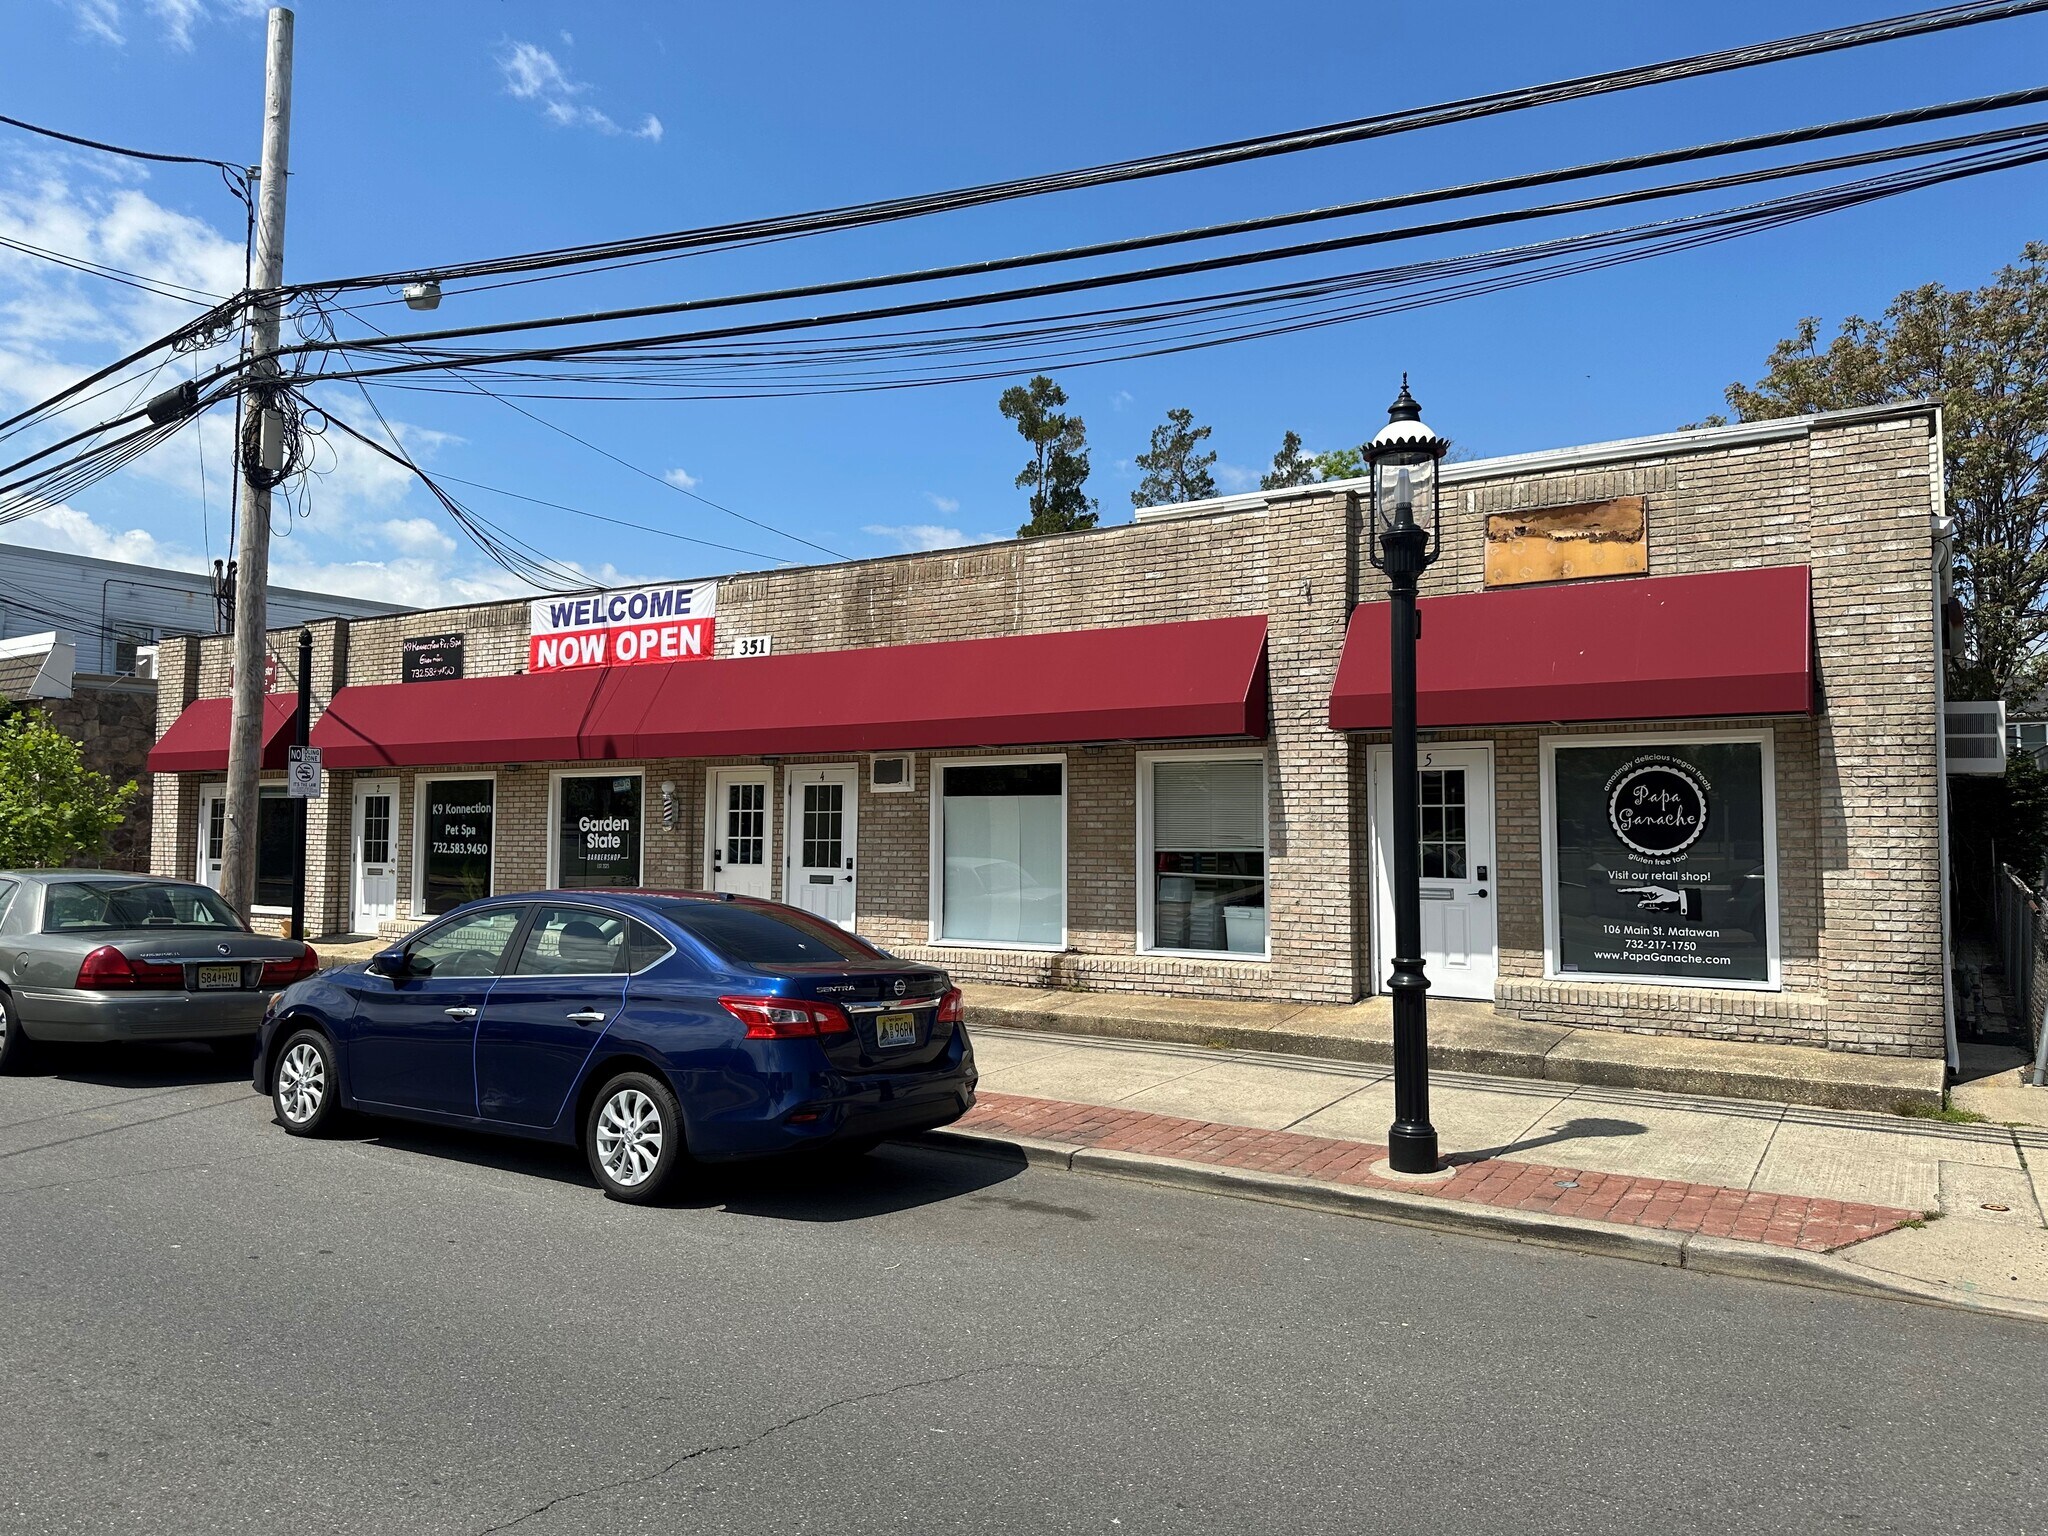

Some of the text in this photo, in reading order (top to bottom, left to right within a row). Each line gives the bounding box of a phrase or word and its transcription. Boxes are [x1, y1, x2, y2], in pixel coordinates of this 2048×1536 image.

[550, 588, 693, 628] WELCOME
[537, 624, 702, 668] NOW OPEN
[739, 638, 766, 655] 351
[291, 749, 302, 760] NO
[1424, 753, 1432, 767] 5
[819, 771, 825, 782] 4
[1603, 754, 1712, 792] amazingly delicious vegan treats
[1633, 784, 1681, 812] Papa
[432, 802, 491, 815] K9 Konnection
[578, 815, 630, 832] Garden
[1619, 804, 1697, 831] Ganache
[445, 823, 476, 838] Pet Spa
[433, 841, 488, 855] 732.583.9450
[586, 833, 621, 849] State
[587, 853, 621, 861] BARBERSHOP
[1627, 852, 1689, 866] gluten free too!
[1608, 870, 1711, 883] Visit our retail shop!
[1603, 925, 1720, 938] 106 Main St. Matawan
[1625, 939, 1697, 951] 732-217-1750
[1594, 951, 1731, 965] www.PapaGanache.com
[816, 985, 856, 993] SENTRA
